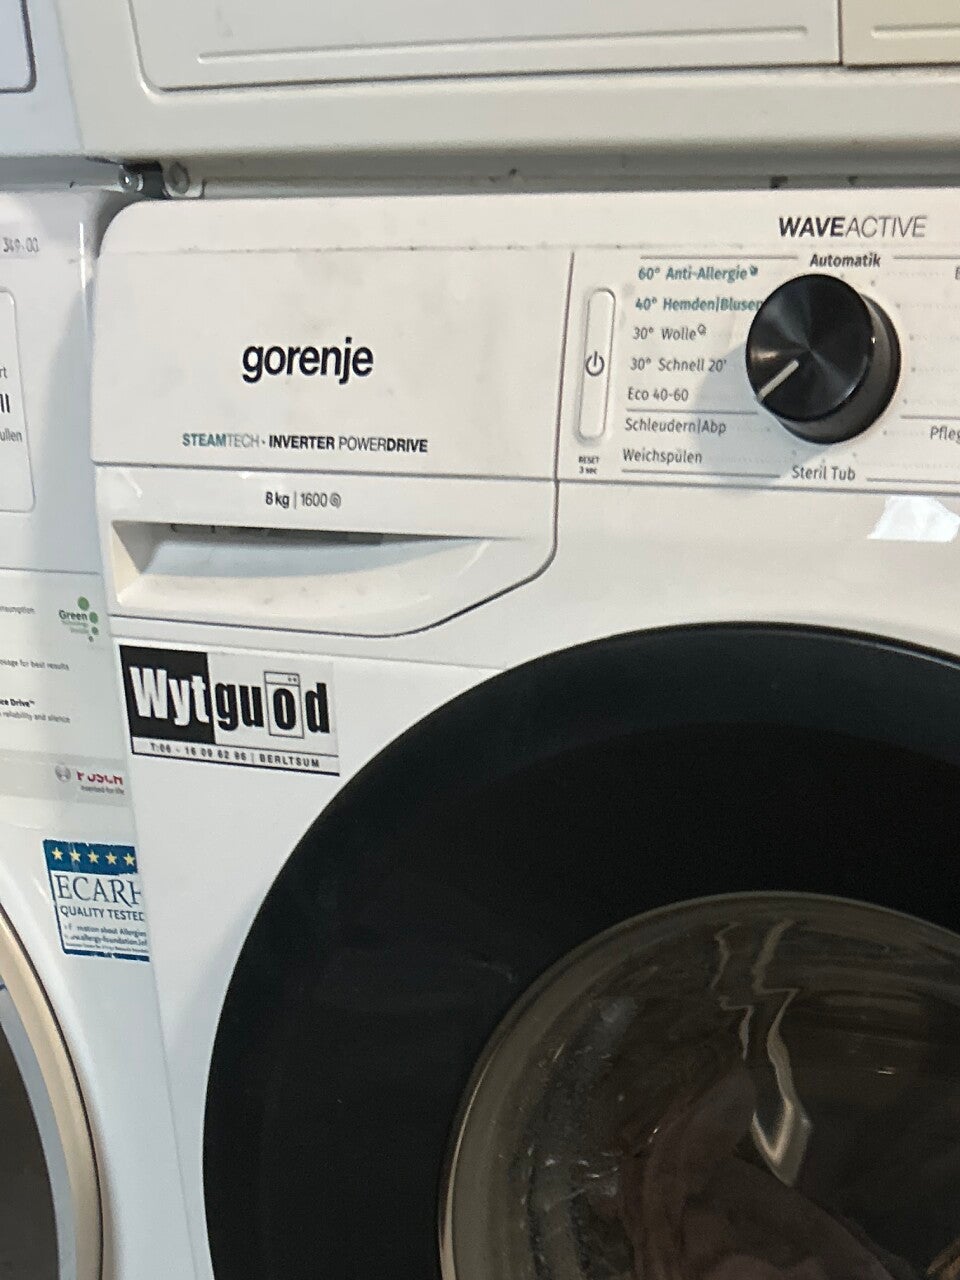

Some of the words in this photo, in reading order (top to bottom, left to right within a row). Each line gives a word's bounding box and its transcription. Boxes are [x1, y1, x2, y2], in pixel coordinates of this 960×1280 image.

[779, 215, 928, 238] WAVEACTIVE
[810, 253, 881, 267] Automatik
[638, 267, 660, 281] 60°
[665, 265, 748, 283] Anti-Allergie
[635, 297, 657, 310] 40°
[633, 327, 654, 340] 30°
[662, 327, 697, 341] Wolle
[242, 337, 373, 383] gorenje
[630, 358, 651, 371] 30°
[658, 358, 704, 372] Schnell
[628, 387, 649, 401] Eco
[654, 388, 689, 402] 40-60
[182, 433, 260, 448] STEAMTECH
[269, 436, 335, 450] INVERTER
[339, 436, 428, 453] POWERDRIVE
[622, 448, 703, 465] Weichspülen
[792, 464, 827, 480] Steril
[831, 466, 856, 481] Tub
[300, 492, 328, 508] 1600
[58, 609, 88, 621] Green
[129, 666, 330, 733] Wytguod
[260, 754, 320, 768] BERLTSUM
[60, 905, 104, 918] QUALITY
